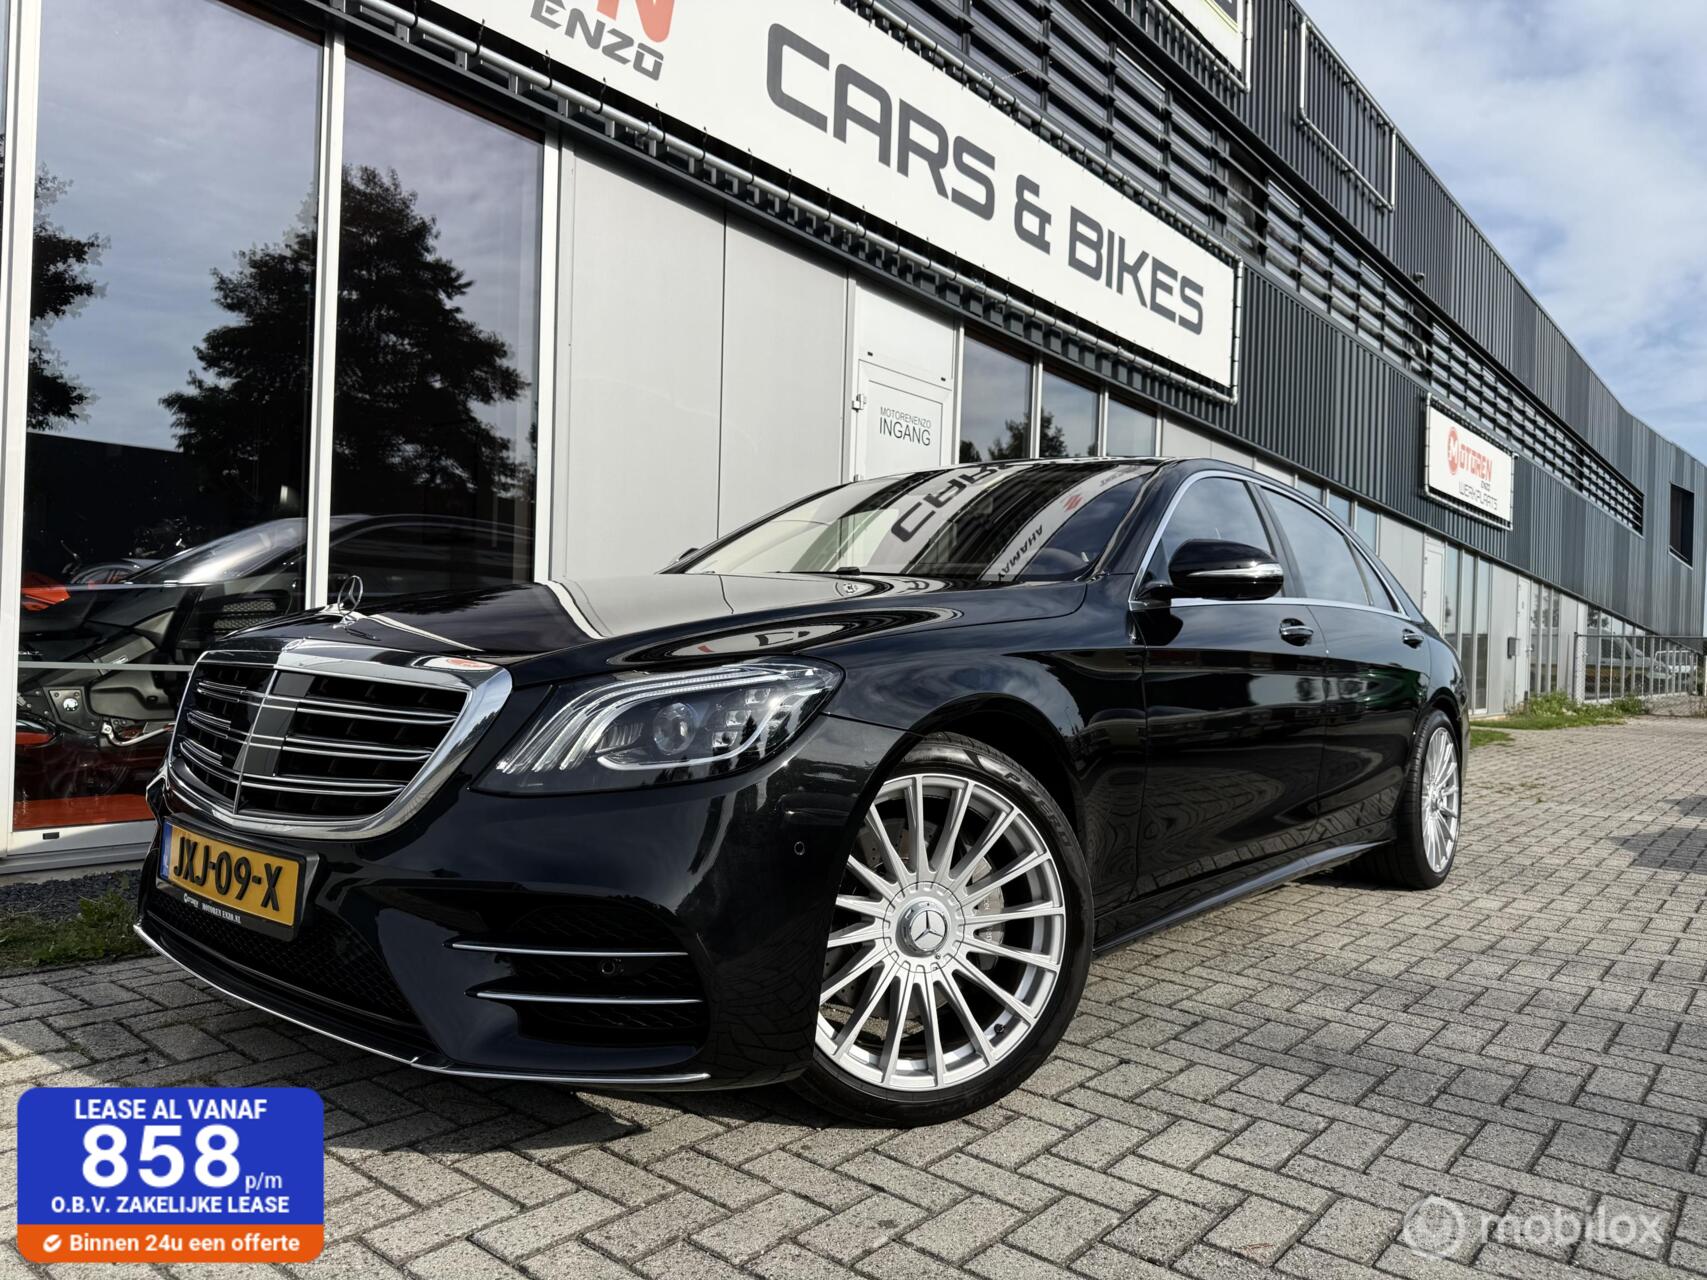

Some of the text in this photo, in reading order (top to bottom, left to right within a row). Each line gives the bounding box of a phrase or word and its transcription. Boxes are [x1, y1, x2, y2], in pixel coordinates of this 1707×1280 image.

[530, 0, 664, 81] ENZO
[767, 23, 1204, 335] CARS & BIKES
[880, 406, 931, 429] MOTORENENZO
[880, 416, 931, 446] INGANG
[174, 836, 283, 912] JXJ-09-X
